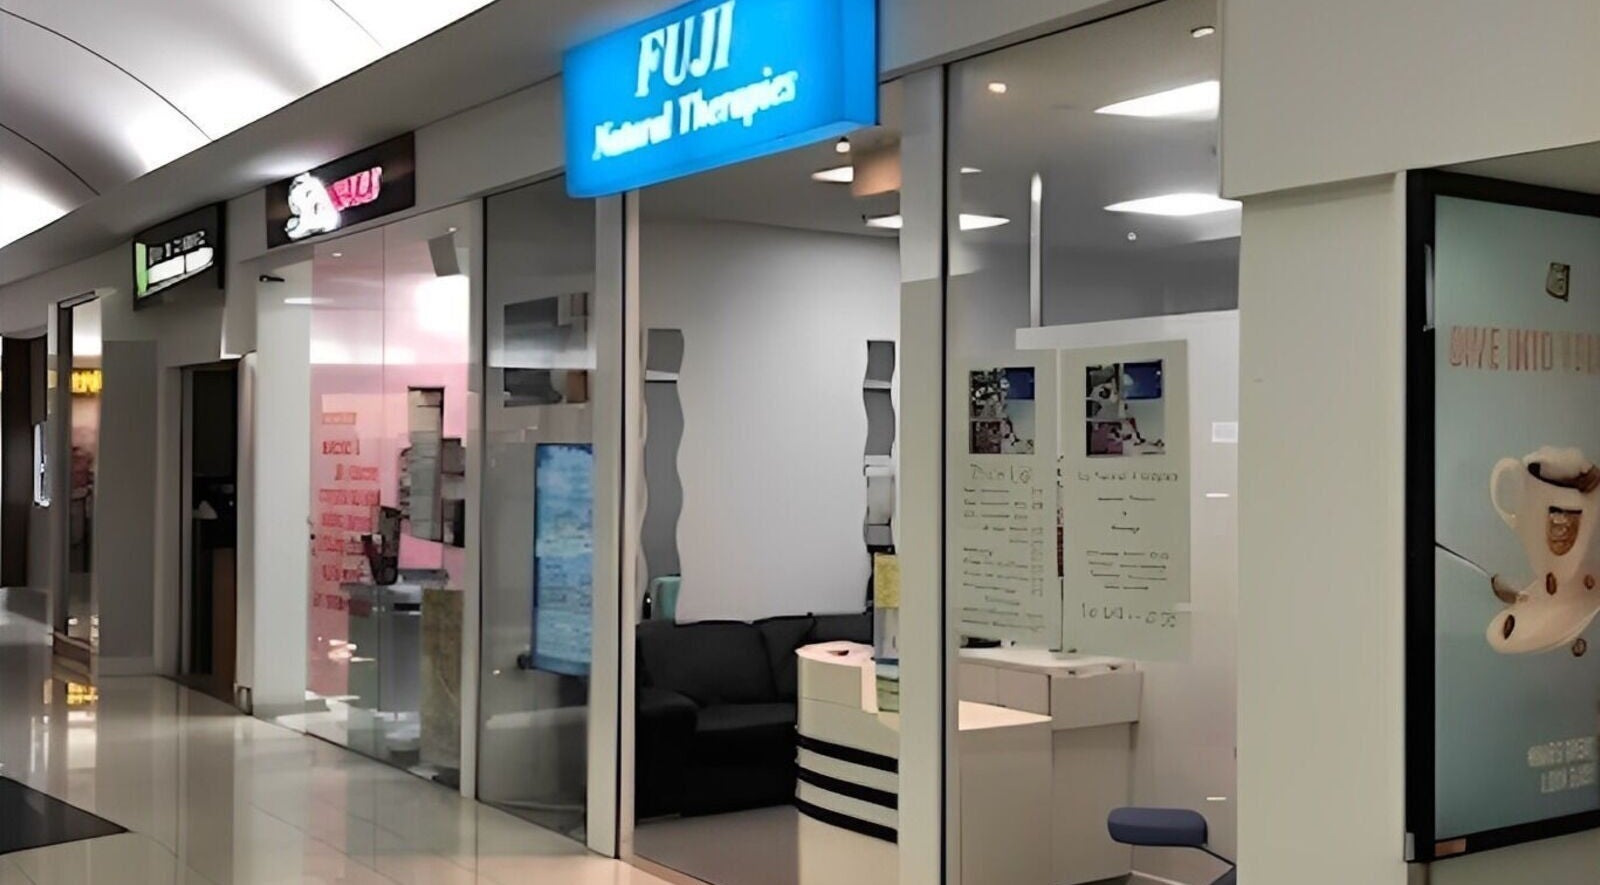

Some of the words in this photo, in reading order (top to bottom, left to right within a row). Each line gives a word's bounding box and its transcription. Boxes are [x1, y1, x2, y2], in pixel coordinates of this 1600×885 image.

[634, 0, 736, 97] FUJI
[592, 101, 673, 161] Natural
[679, 66, 798, 135] Therapies
